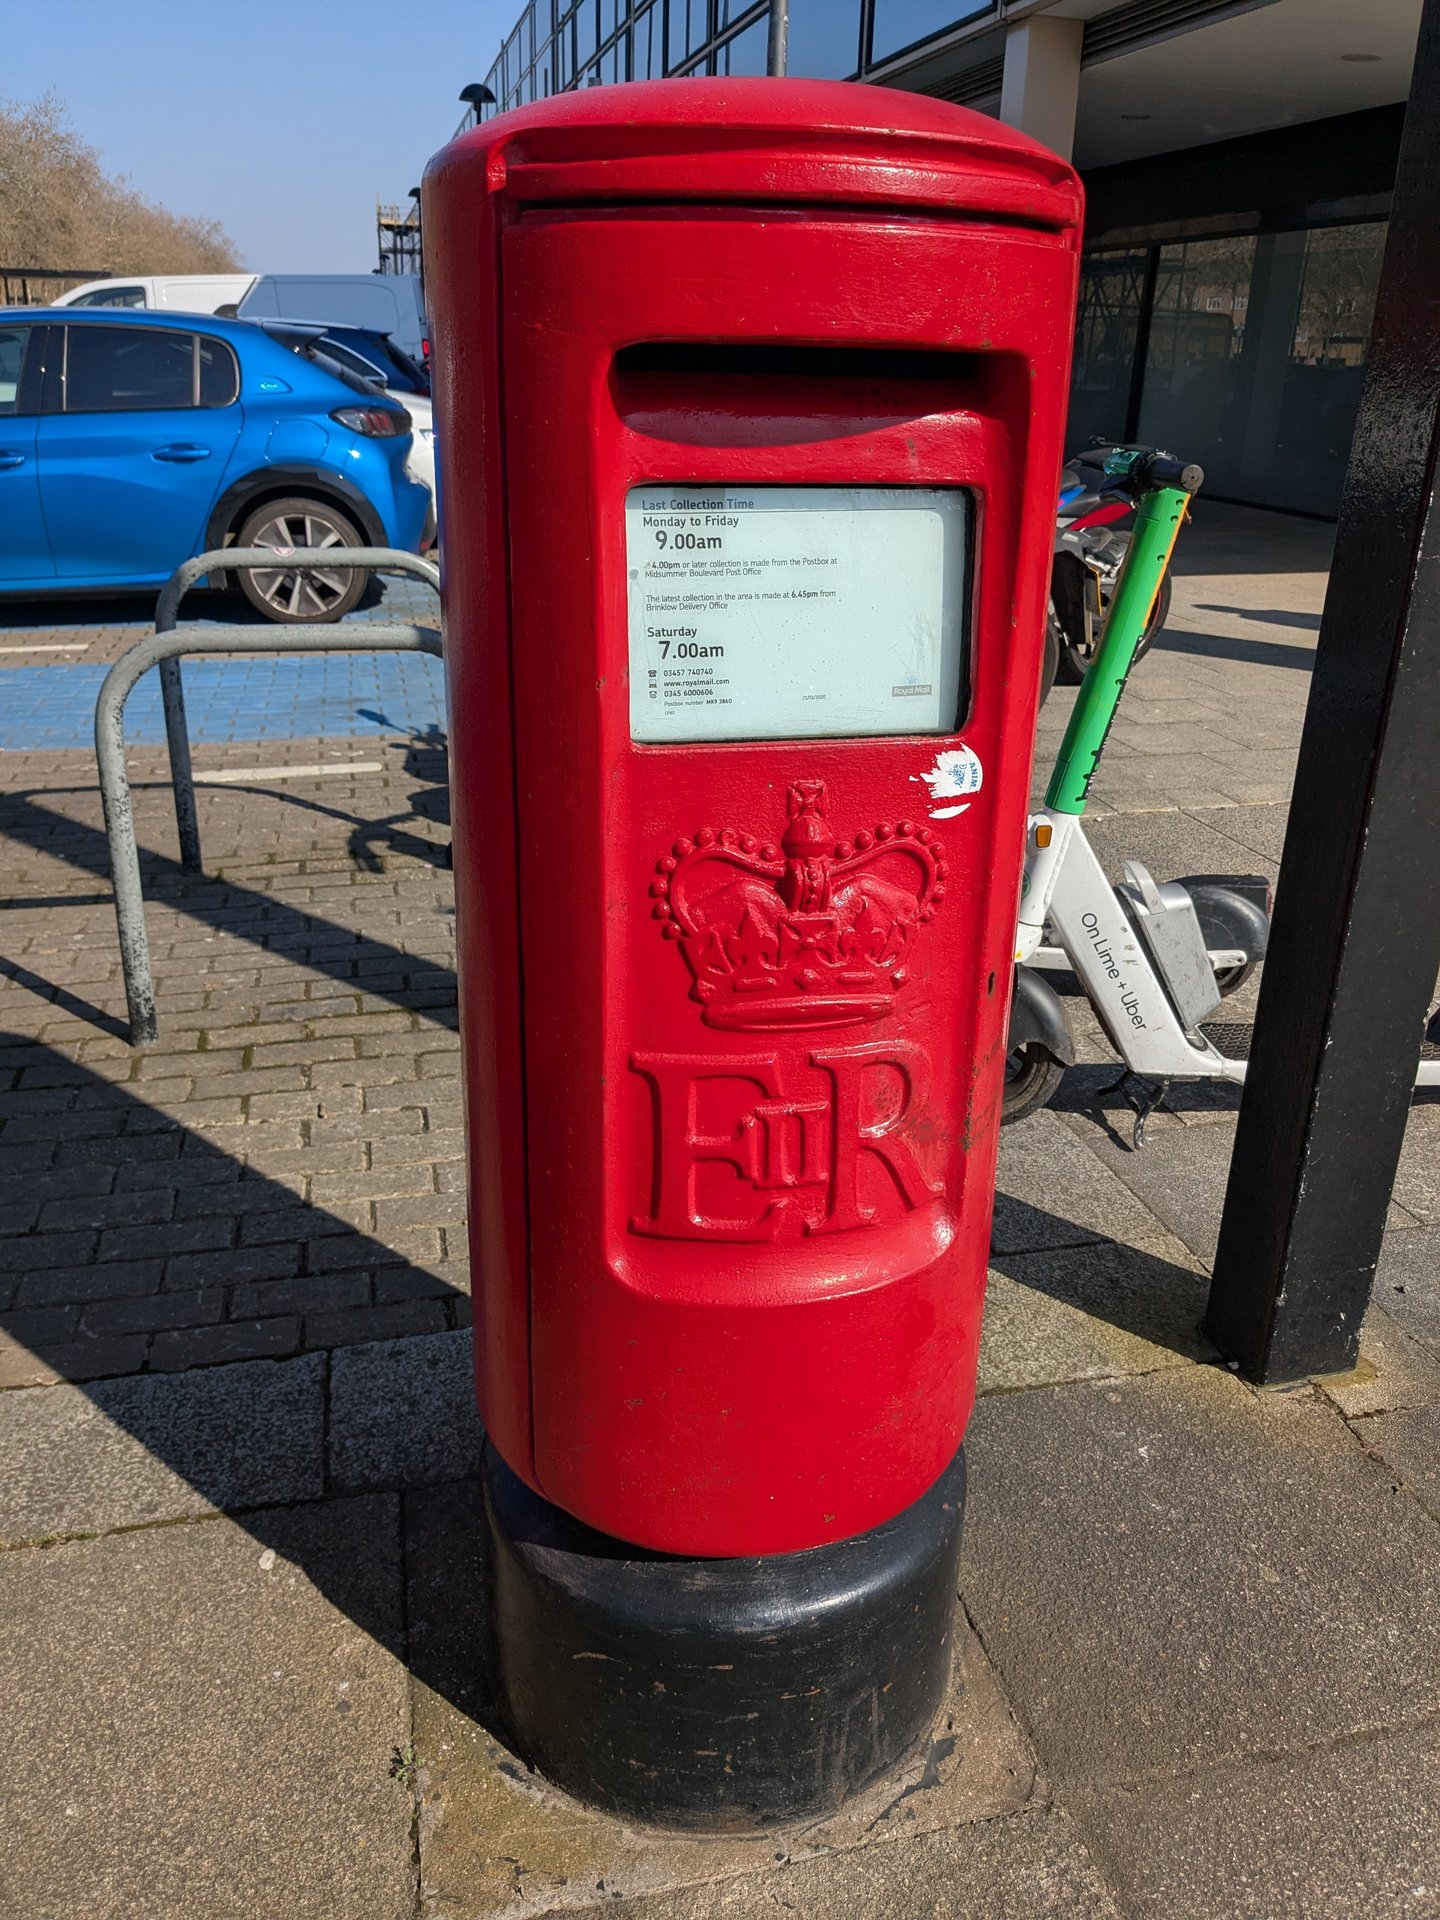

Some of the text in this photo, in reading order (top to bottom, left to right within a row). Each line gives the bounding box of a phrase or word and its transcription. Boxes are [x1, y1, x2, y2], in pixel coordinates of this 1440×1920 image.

[642, 499, 754, 510] Last Collection Time
[642, 515, 739, 528] Monday to Friday
[656, 530, 722, 550] 9.00am
[651, 560, 680, 570] 4.00pm
[691, 560, 708, 568] later
[709, 559, 741, 568] collection
[742, 559, 749, 567] is
[750, 559, 770, 567] made
[771, 558, 787, 567] from
[789, 557, 801, 566] the
[802, 557, 829, 566] Postbox
[830, 557, 838, 565] at
[645, 568, 762, 578] Midsummer Boulevard Post Office
[646, 594, 660, 602] The
[661, 593, 681, 602] latest
[682, 593, 714, 601] collection
[716, 592, 723, 601] in
[724, 592, 737, 601] the
[738, 592, 753, 600] area
[762, 591, 781, 599] made
[782, 591, 790, 599] at
[791, 590, 819, 600] 6.45pm
[820, 589, 837, 598] from
[646, 601, 728, 611] Brinklow Delivery Office
[647, 626, 698, 638] Saturday
[658, 641, 724, 660] 7.00am
[663, 668, 713, 677] 03457 740740
[663, 679, 730, 688] www.royalmail.com
[663, 688, 714, 698] 0345 6000606
[894, 685, 931, 696] Royal Mail
[1081, 912, 1147, 1030] On Lime + Uber
